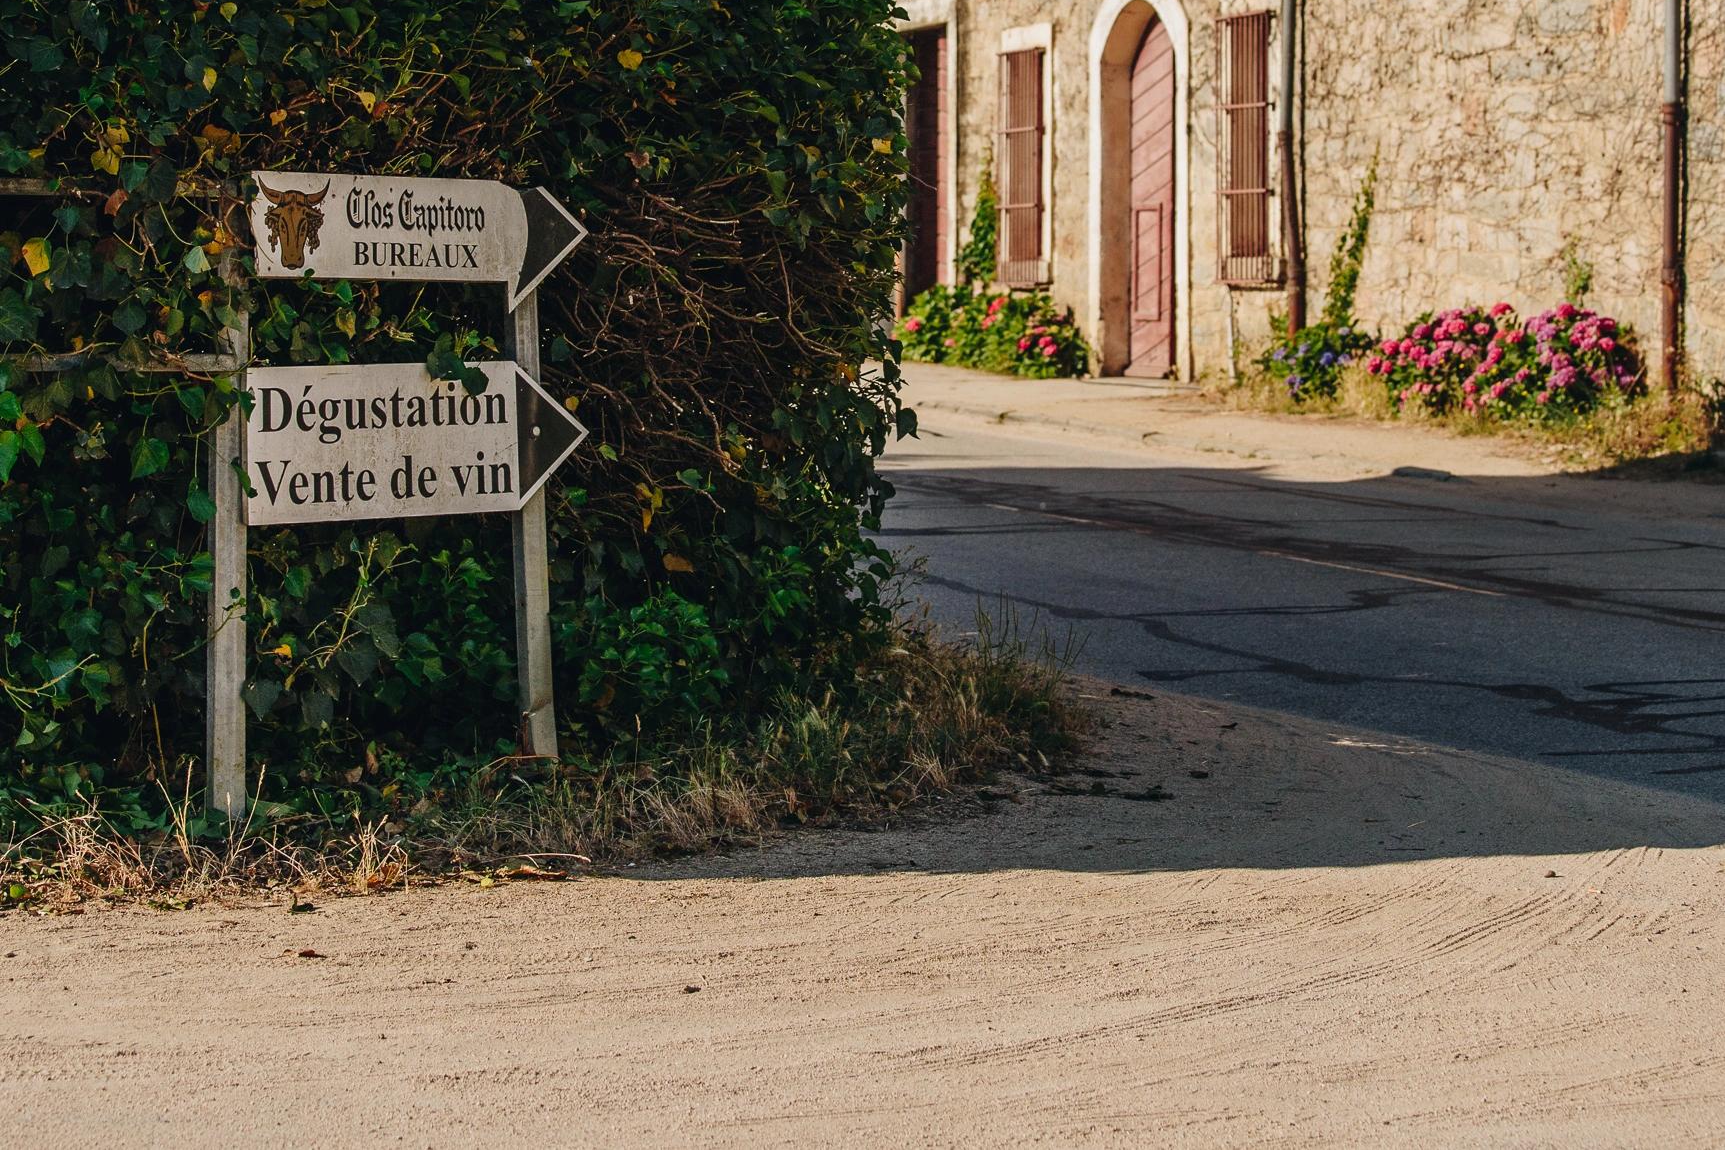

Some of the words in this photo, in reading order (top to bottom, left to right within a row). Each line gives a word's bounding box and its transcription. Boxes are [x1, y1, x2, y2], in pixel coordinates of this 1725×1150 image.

[346, 186, 394, 229] Clos
[398, 188, 485, 237] Capitoro
[353, 241, 479, 268] BUREAUX
[257, 382, 508, 444] Dégustation
[255, 459, 377, 506] Vente
[390, 455, 437, 500] de
[450, 451, 514, 497] vin
